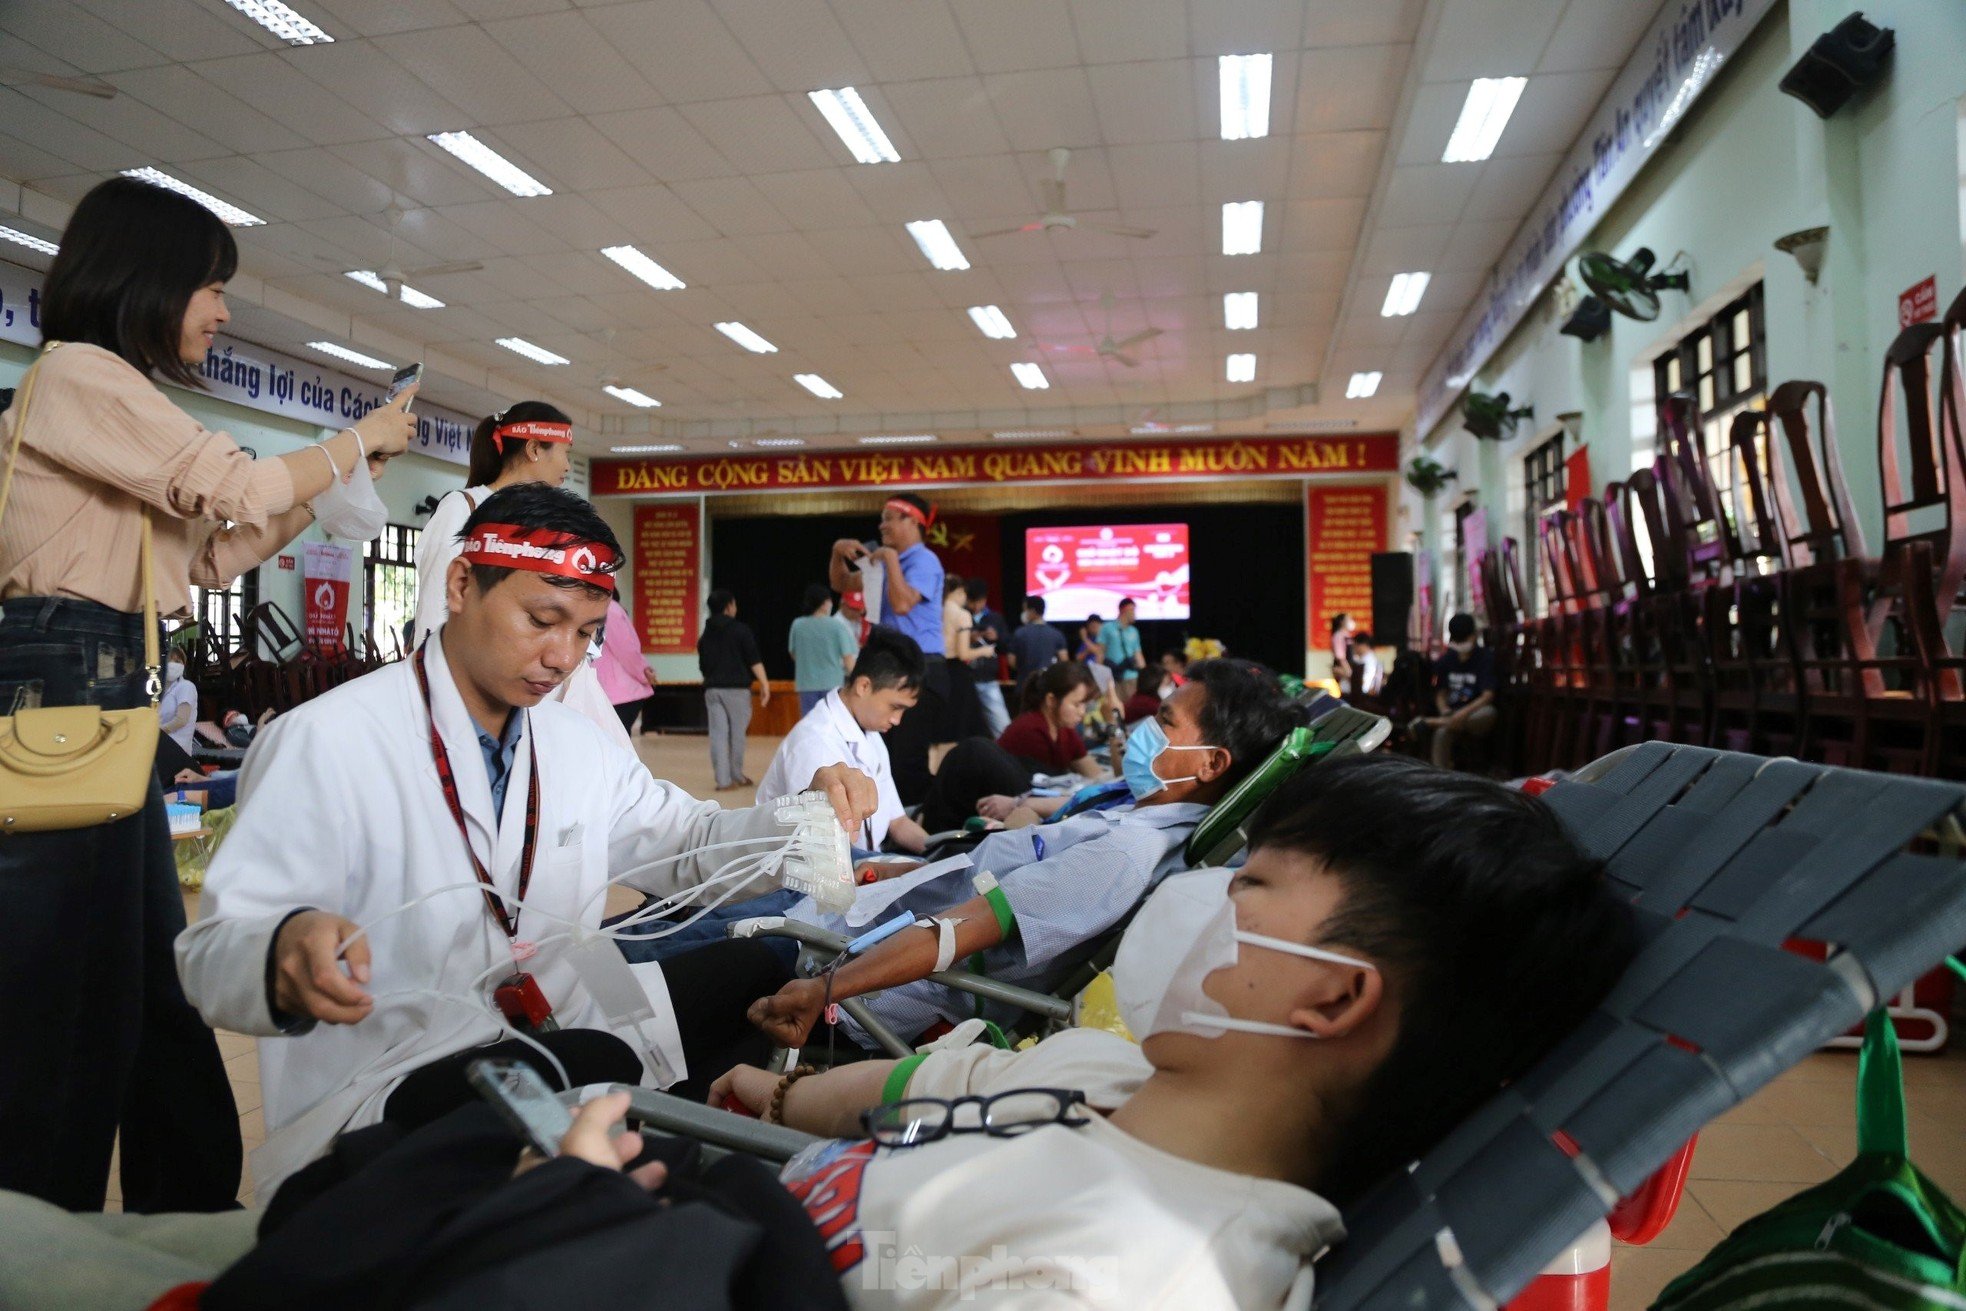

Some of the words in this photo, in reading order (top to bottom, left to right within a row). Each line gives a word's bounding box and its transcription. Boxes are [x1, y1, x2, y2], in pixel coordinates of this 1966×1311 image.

[269, 364, 294, 404] lợi
[301, 376, 334, 413] của
[435, 416, 461, 453] Việt
[617, 461, 689, 489] ĐẢNG
[697, 457, 770, 490] CỘNG
[777, 454, 833, 484] SẢN
[840, 453, 905, 485] VIỆT
[911, 454, 976, 480] NAM
[983, 451, 1082, 482] QUANG
[1091, 447, 1171, 475] VINH
[1178, 440, 1269, 473] MUÔN
[1278, 440, 1350, 470] NĂM
[483, 532, 566, 565] Tiênphong
